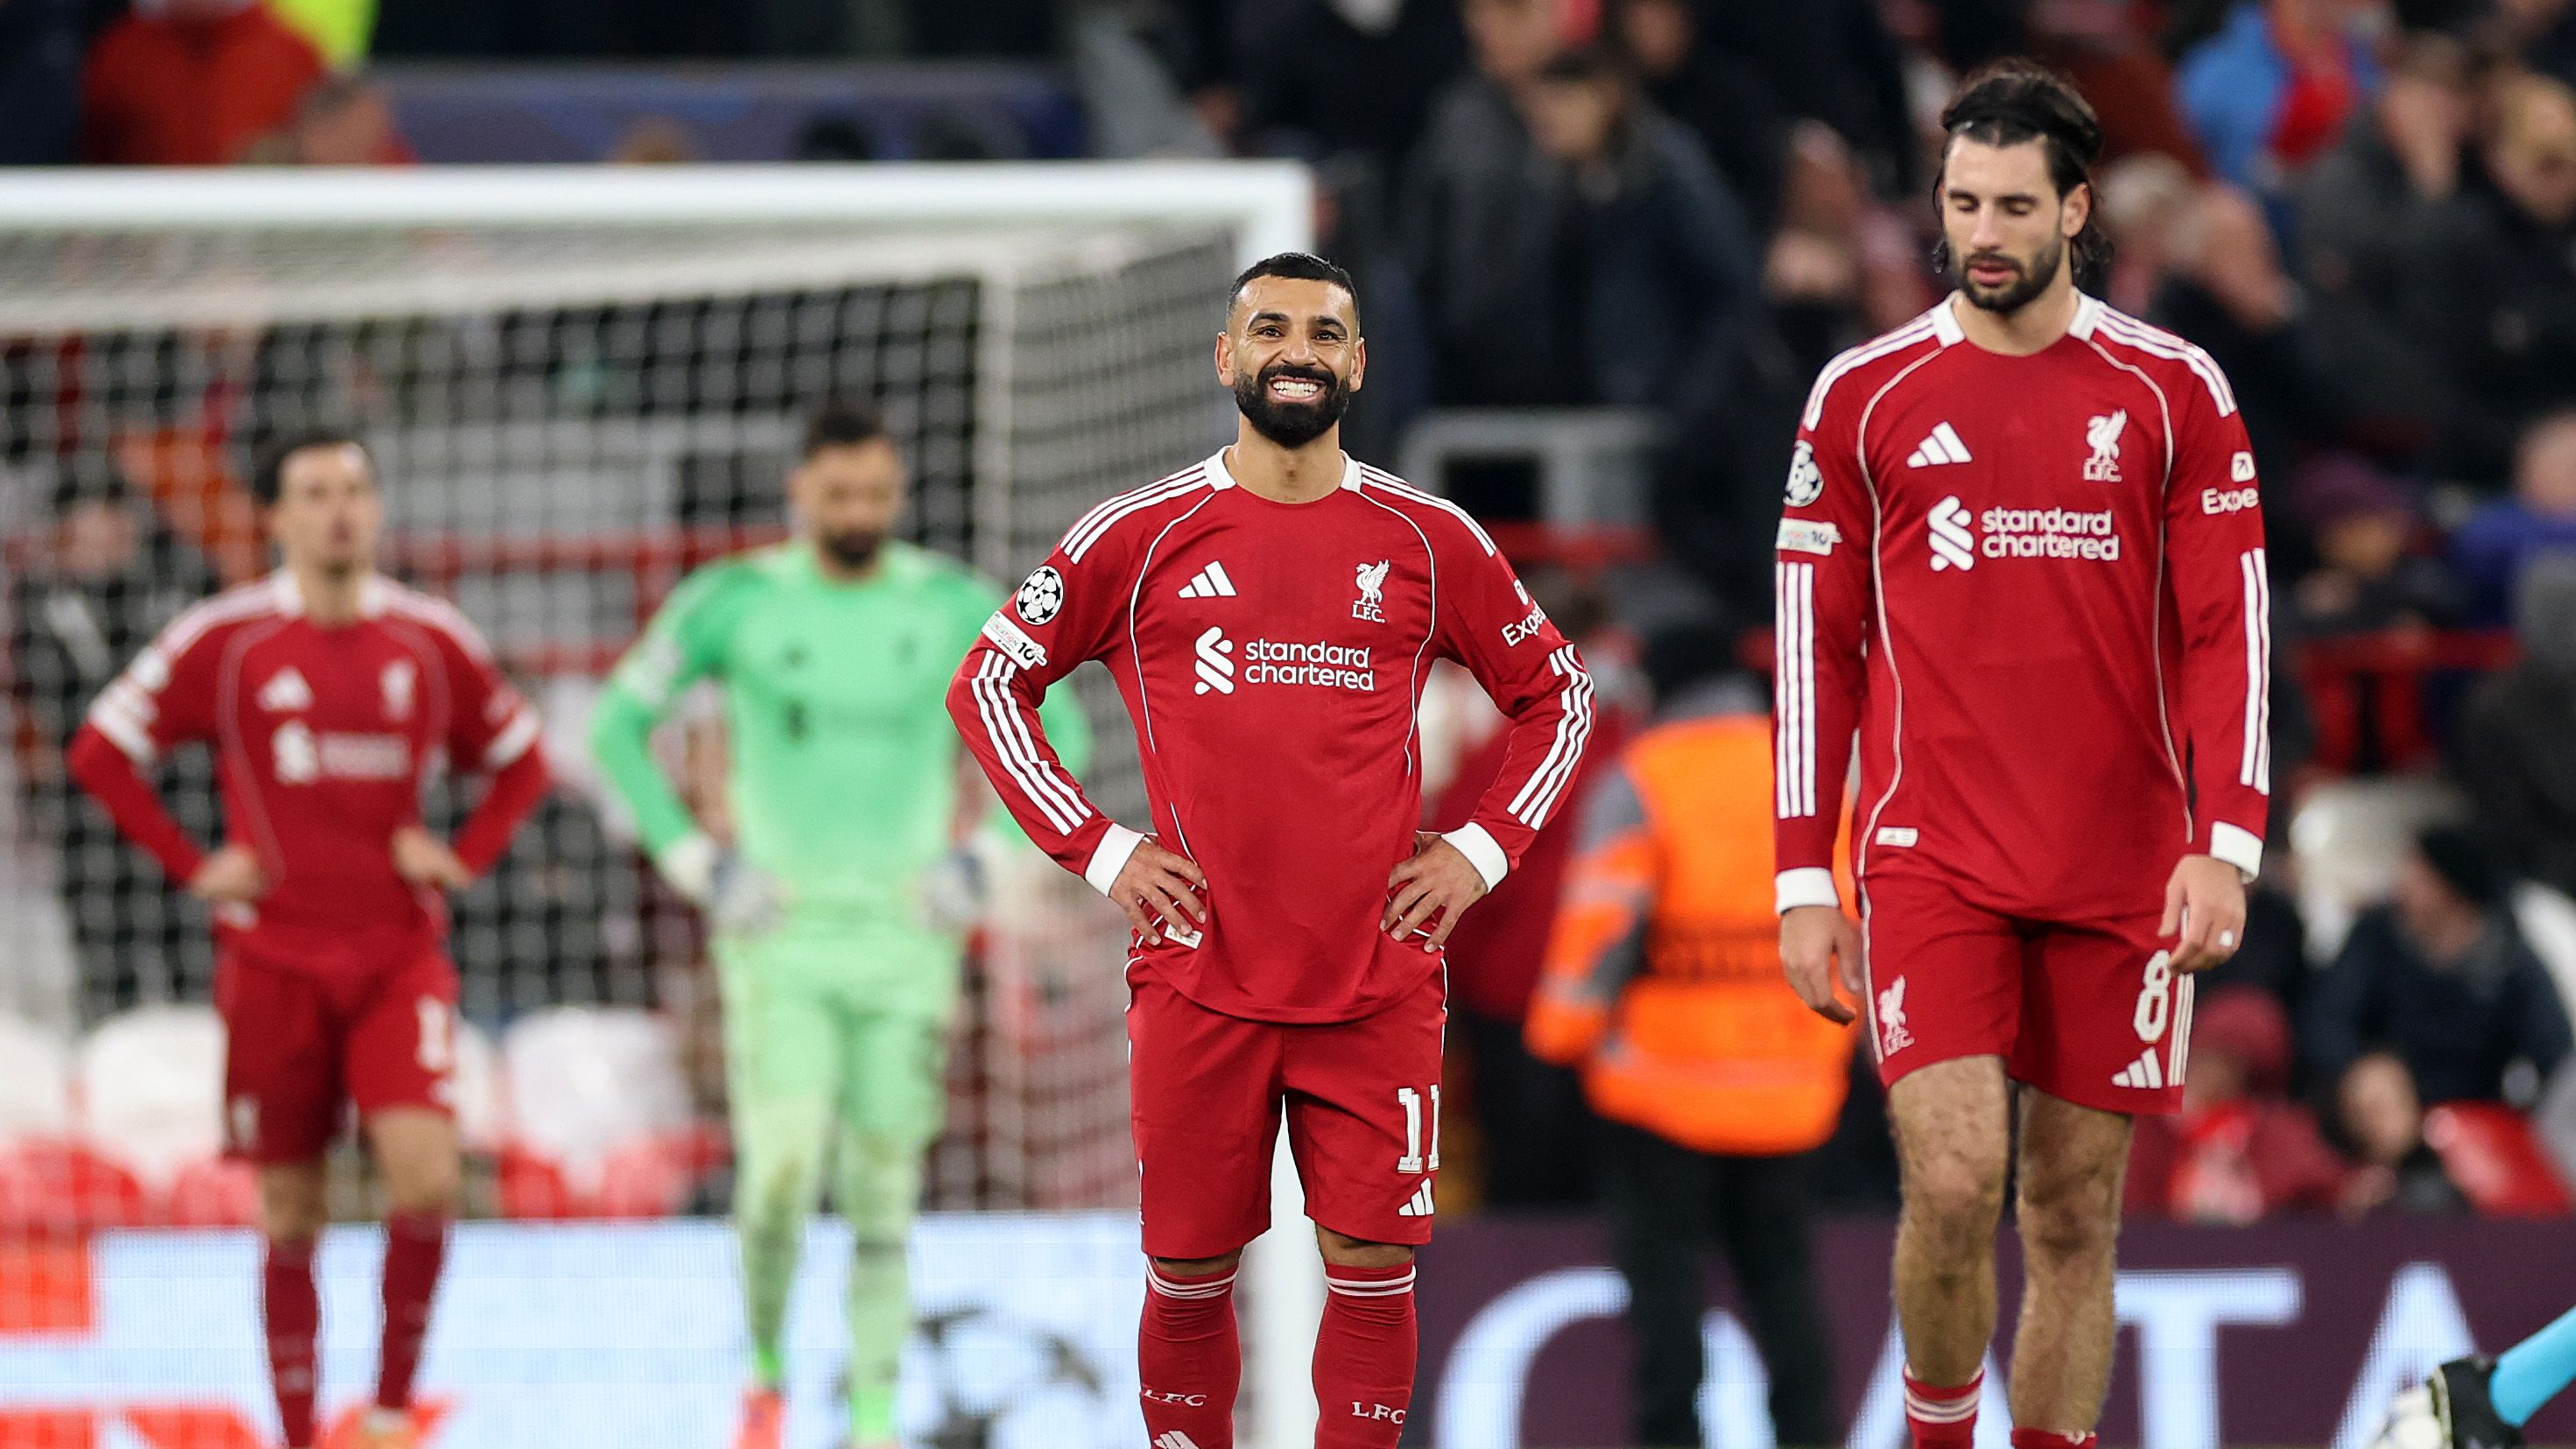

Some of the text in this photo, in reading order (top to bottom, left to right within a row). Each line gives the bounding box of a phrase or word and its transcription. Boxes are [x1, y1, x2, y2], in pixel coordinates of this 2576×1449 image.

[1981, 505, 2112, 536] standard
[1981, 533, 2120, 561] chartered
[1031, 584, 1045, 606] 6
[1245, 637, 1370, 668] standard
[1244, 661, 1375, 692] chartered
[2133, 949, 2171, 1044] 8
[1397, 1084, 1440, 1173] 11
[1144, 1389, 1207, 1407] LFC
[1351, 1401, 1407, 1424] LFC
